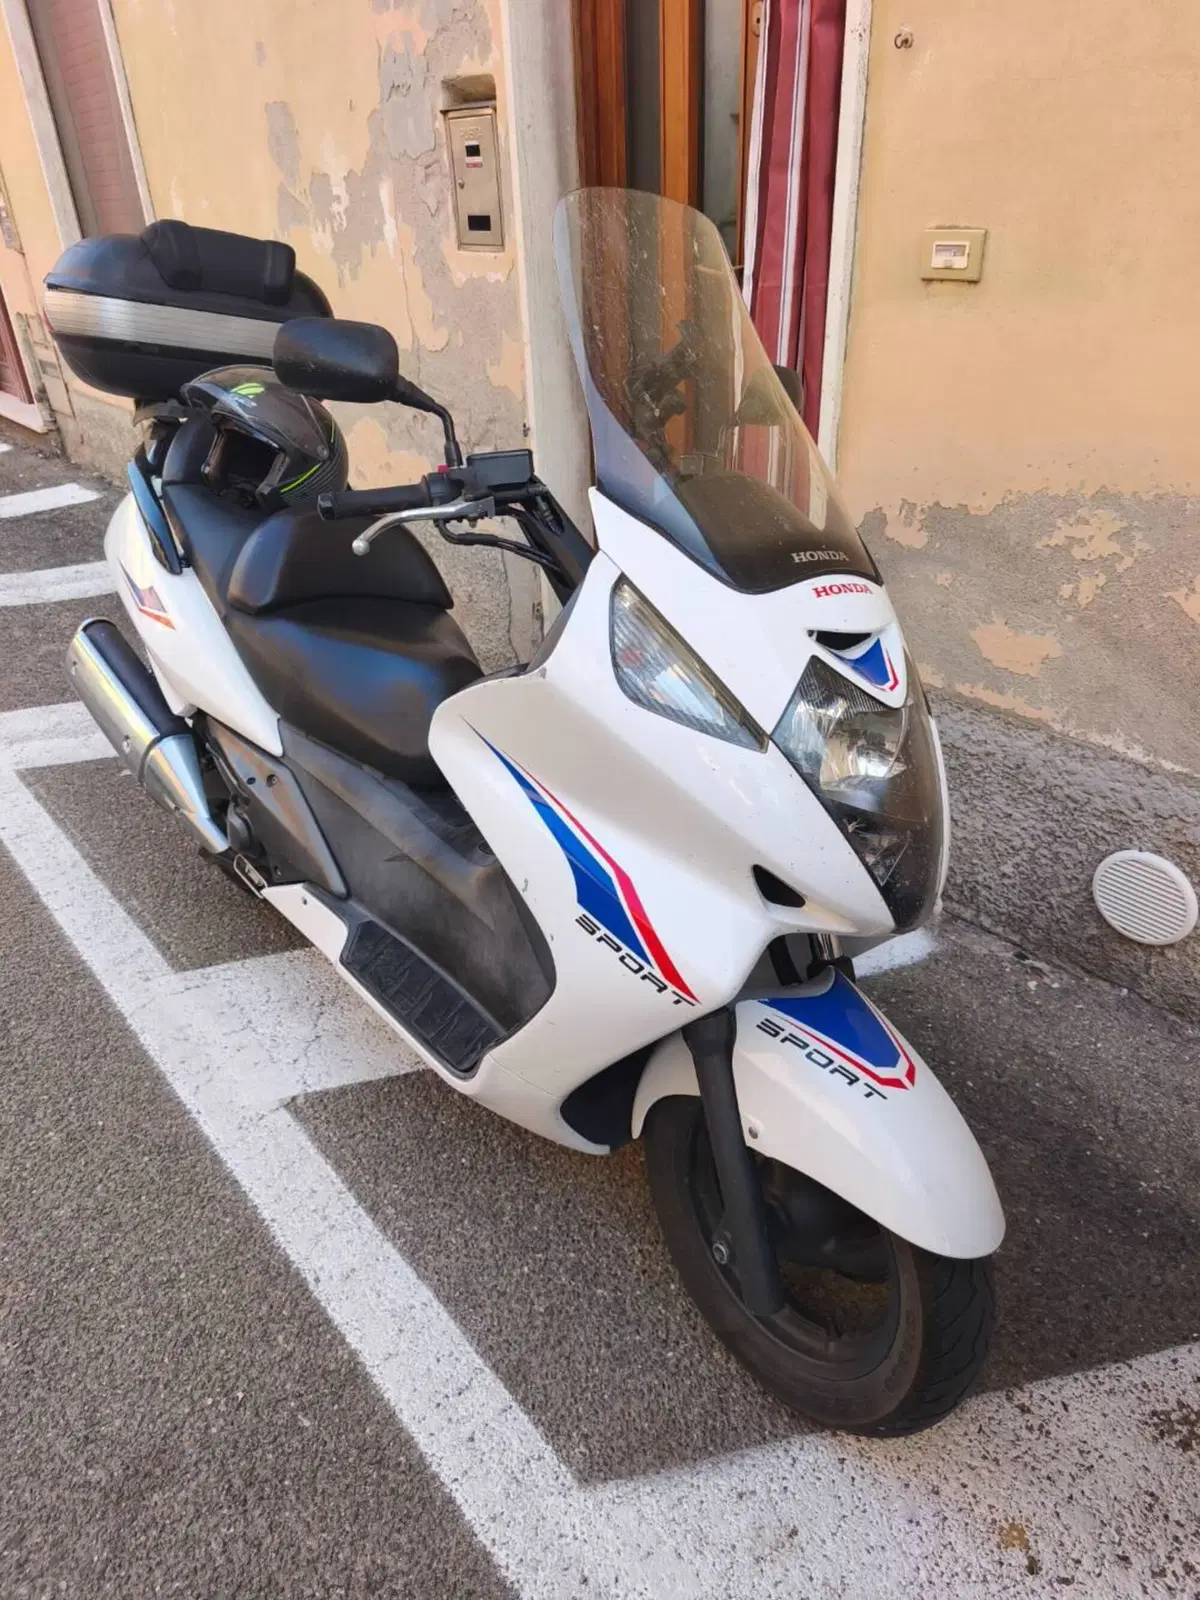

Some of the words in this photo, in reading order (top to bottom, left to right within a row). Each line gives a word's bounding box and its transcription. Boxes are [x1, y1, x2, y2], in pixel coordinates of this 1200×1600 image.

[791, 550, 849, 563] HONDA
[812, 583, 873, 598] HONDA
[575, 913, 696, 1007] SPORT
[756, 1018, 888, 1100] SPORT
